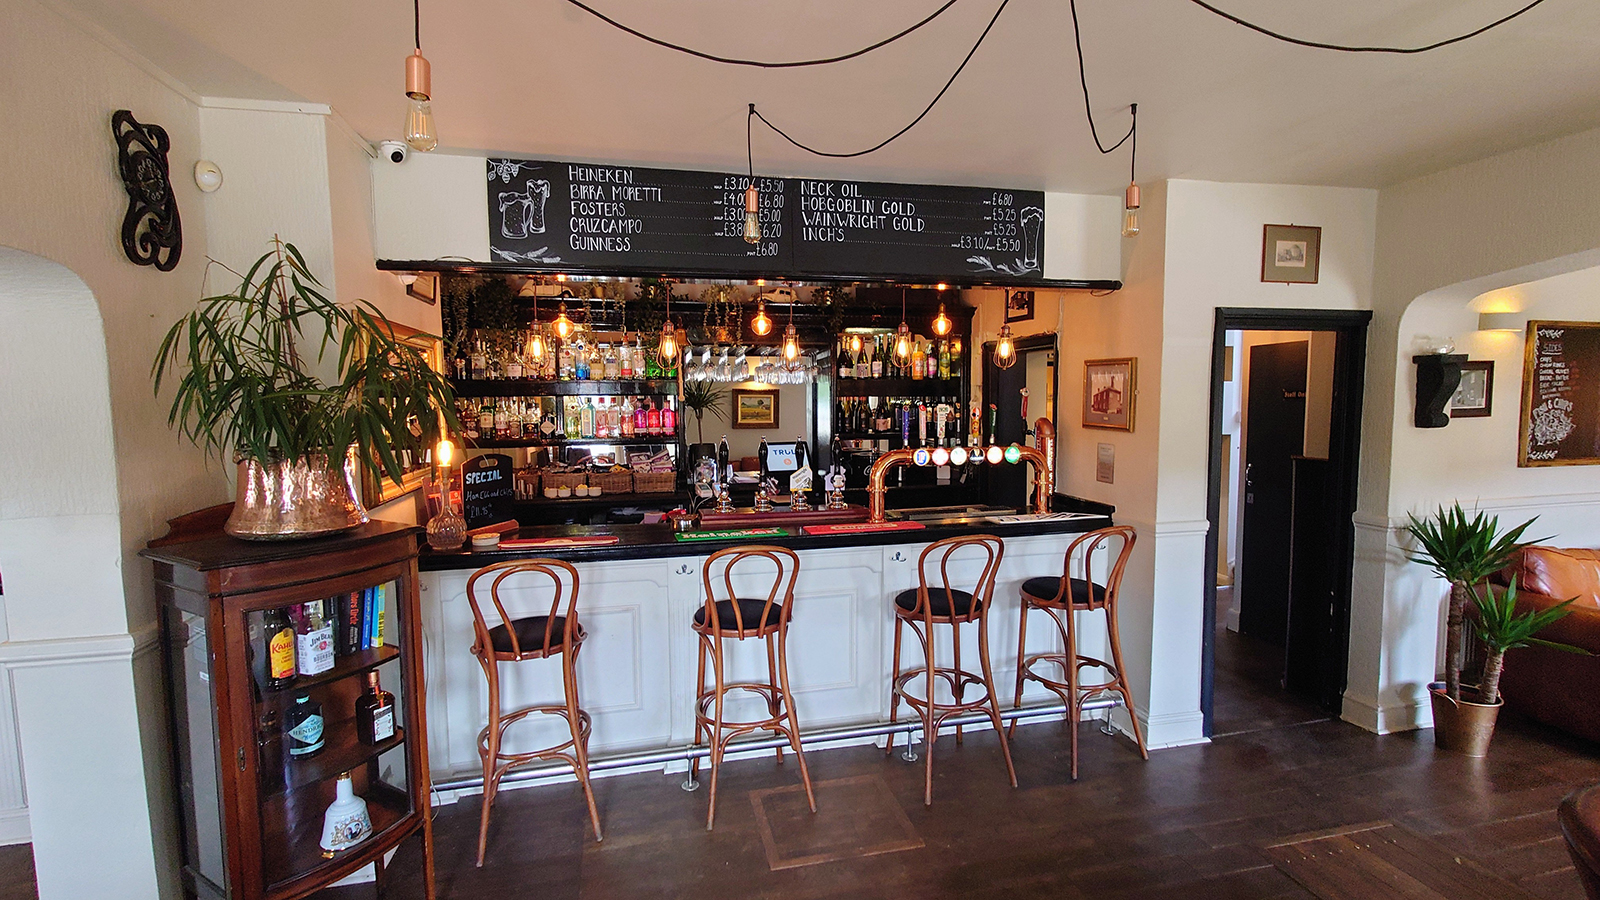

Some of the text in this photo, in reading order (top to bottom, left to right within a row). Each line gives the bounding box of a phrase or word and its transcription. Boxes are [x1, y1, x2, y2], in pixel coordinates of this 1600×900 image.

[568, 165, 633, 184] HEINEKEN
[724, 176, 750, 190] £3.10
[760, 178, 784, 193] £5.50
[569, 183, 606, 200] BIRRA
[611, 185, 662, 202] MORETTI
[759, 193, 785, 208] £6.80
[800, 180, 836, 197] NECK
[841, 183, 862, 198] OIL
[570, 200, 626, 217] FOSTERS
[801, 196, 875, 214] HOBGOBLIN
[881, 200, 916, 216] GOLD
[569, 216, 643, 234] CRUZCAMPO
[801, 211, 887, 230] WAINWRIGHT
[892, 216, 926, 232] GOLD
[569, 233, 631, 252] GUINNESS
[466, 470, 502, 484] SPECIAL
